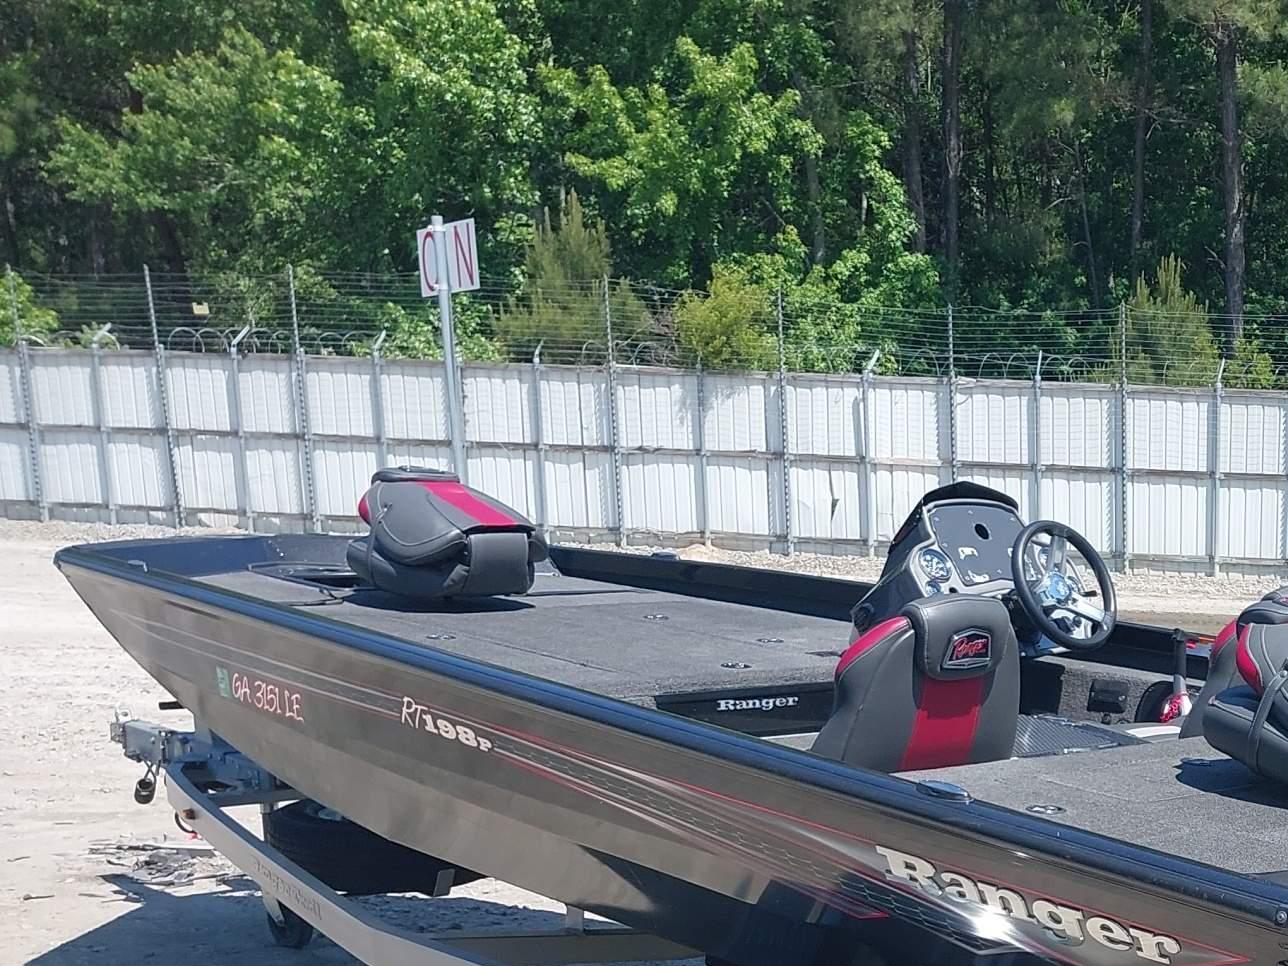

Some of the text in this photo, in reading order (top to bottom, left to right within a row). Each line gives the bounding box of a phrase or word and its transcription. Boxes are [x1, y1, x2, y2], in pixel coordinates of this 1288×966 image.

[232, 673, 252, 703] GA
[254, 681, 282, 714] 3151
[284, 690, 305, 724] LE
[716, 696, 799, 711] Ranger
[875, 845, 1182, 965] Ranger
